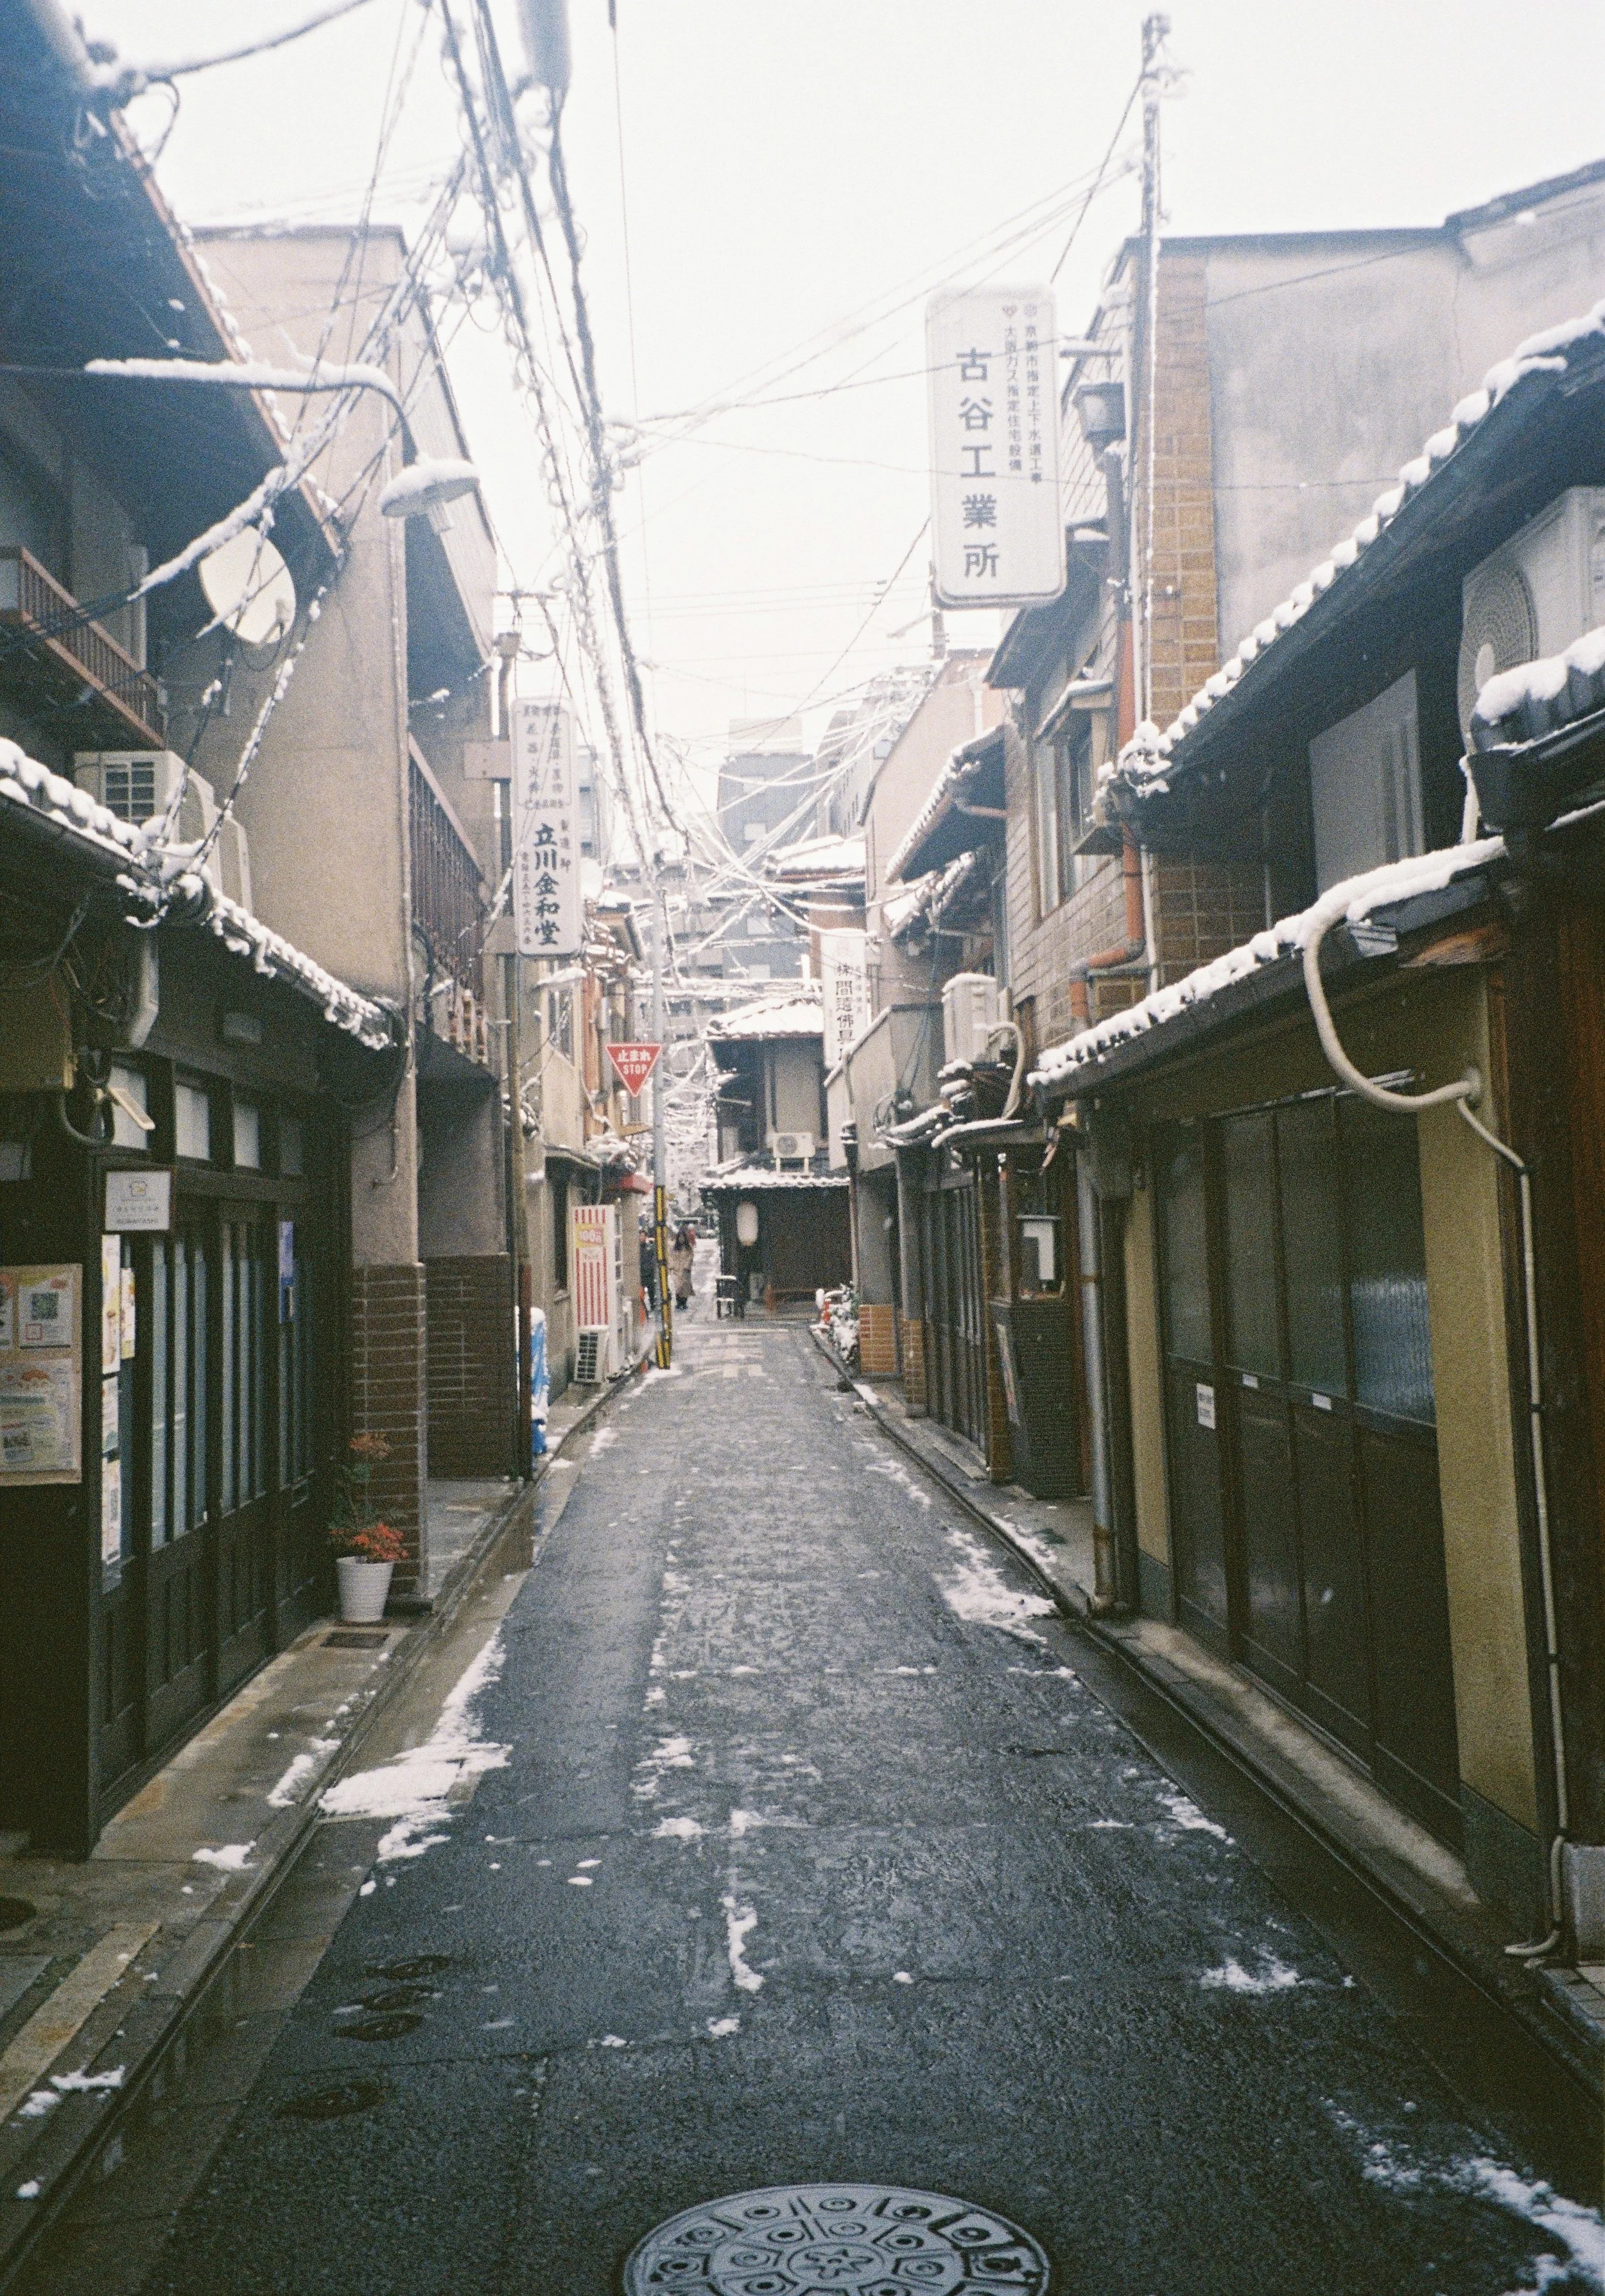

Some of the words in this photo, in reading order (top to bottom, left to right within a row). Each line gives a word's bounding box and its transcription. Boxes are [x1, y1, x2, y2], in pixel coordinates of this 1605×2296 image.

[956, 347, 1000, 578] 古谷工業所
[534, 822, 561, 946] 立川金和堂
[617, 1049, 652, 1062] 止まれ
[623, 1064, 647, 1075] STOP
